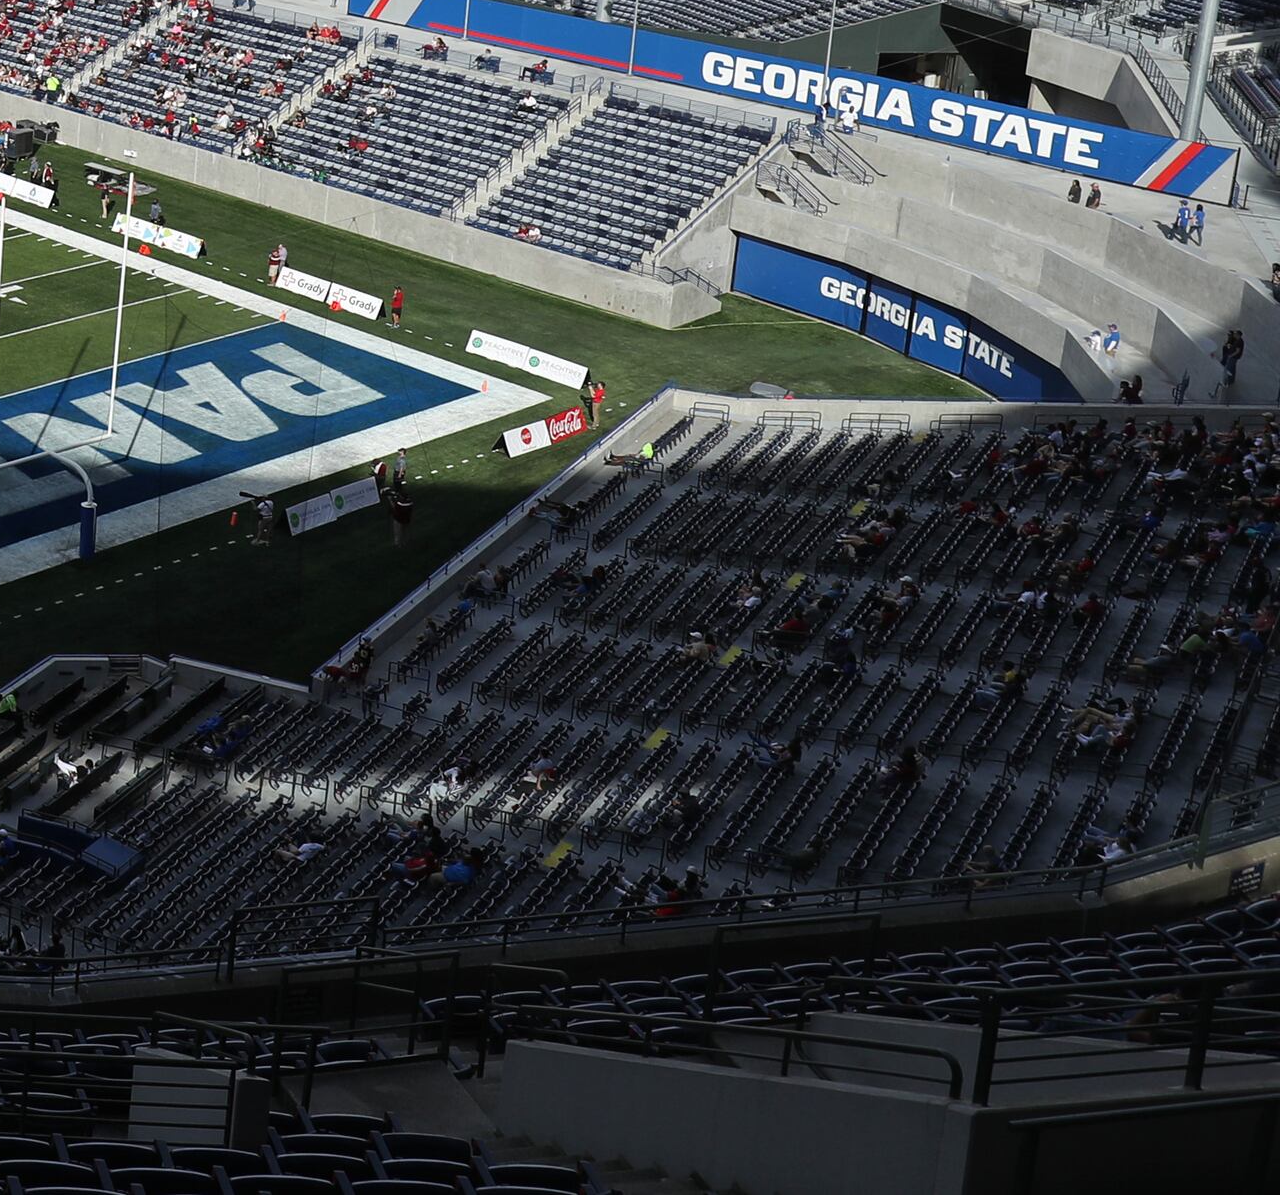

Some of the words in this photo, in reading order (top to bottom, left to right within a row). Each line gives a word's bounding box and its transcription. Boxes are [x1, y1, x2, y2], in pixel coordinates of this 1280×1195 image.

[701, 51, 915, 128] GEORGIA
[928, 98, 1104, 169] STATE
[297, 278, 326, 296] Grady
[348, 295, 377, 314] Grady
[820, 274, 937, 336] GEORGIA
[943, 324, 1016, 380] STATE
[483, 340, 525, 360] PEACHTREE
[540, 358, 582, 380] PEACHTREE
[549, 409, 582, 440] Coca-Cola
